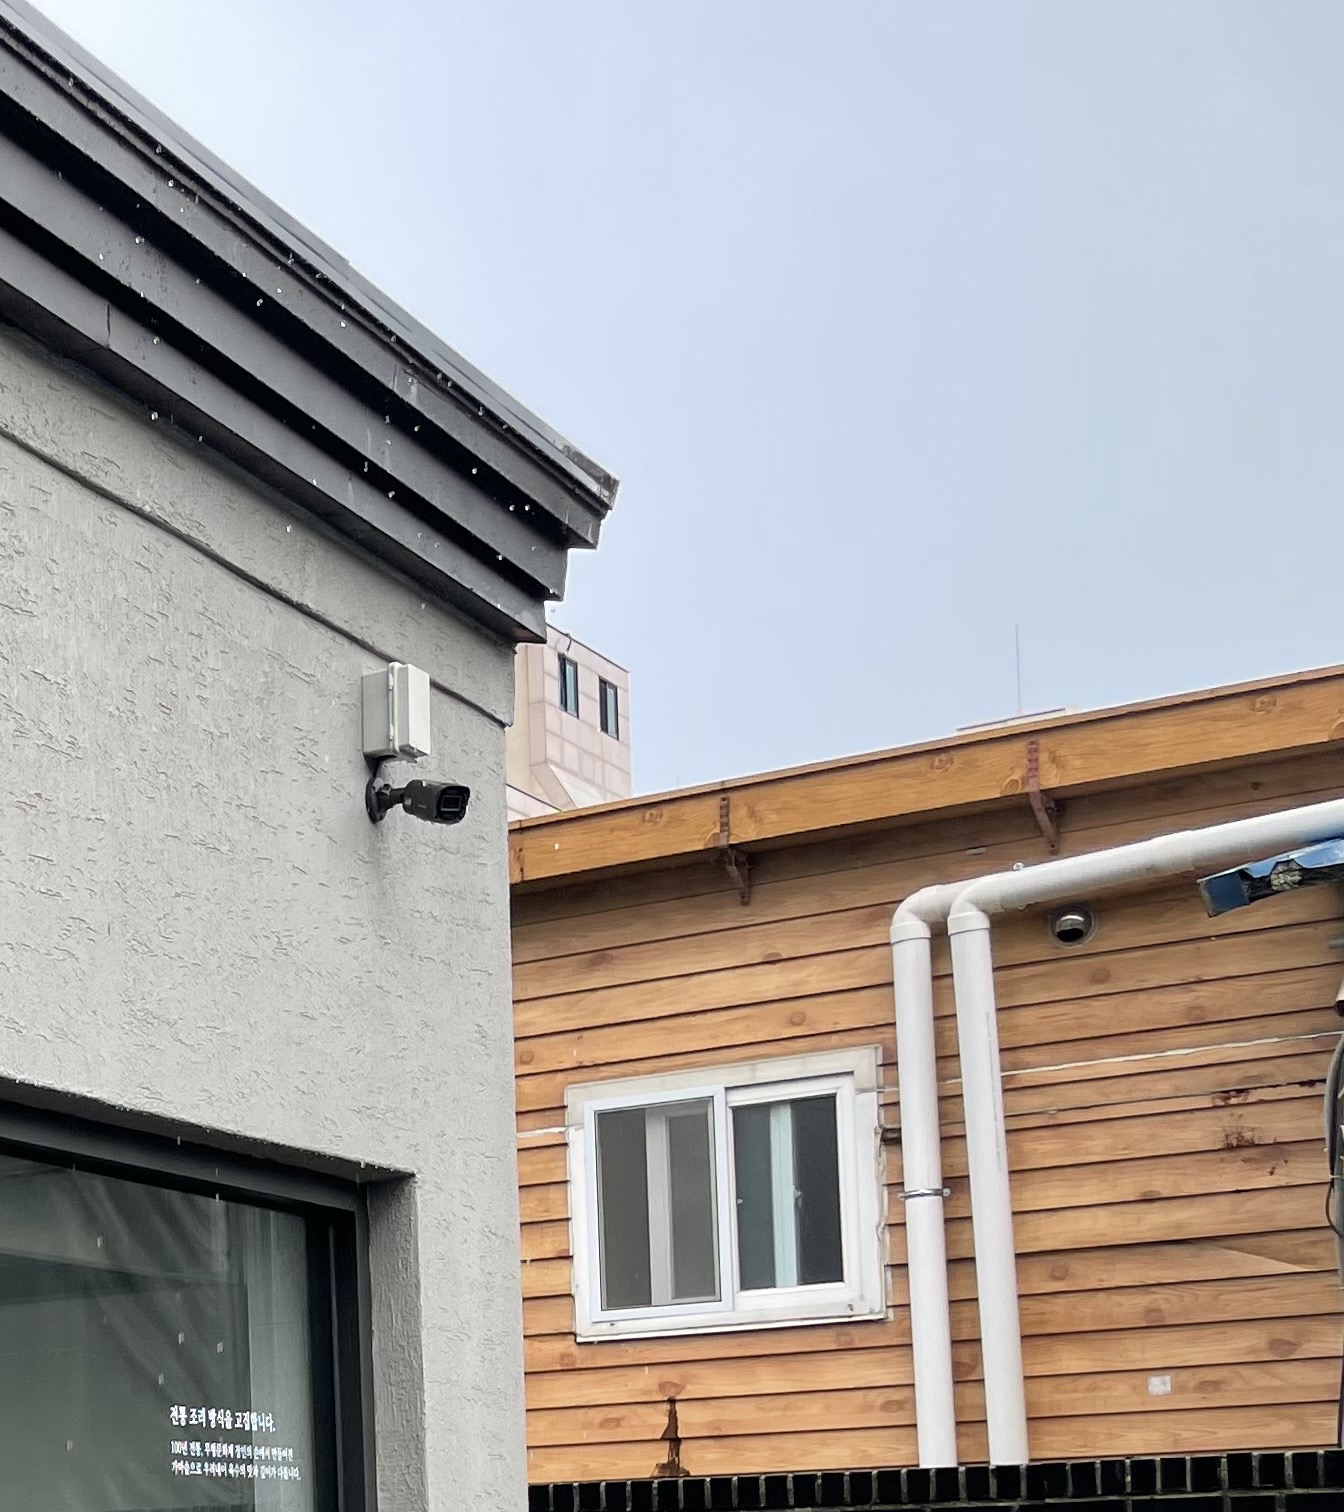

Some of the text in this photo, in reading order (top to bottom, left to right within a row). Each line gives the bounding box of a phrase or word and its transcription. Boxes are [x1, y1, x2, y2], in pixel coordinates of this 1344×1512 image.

[169, 1404, 277, 1433] 전통 조리 방식을 고집합니다.
[171, 1441, 188, 1456] 100년
[235, 1444, 252, 1460] 장인의
[253, 1445, 270, 1461] 손에서
[271, 1447, 294, 1463] 만들어진
